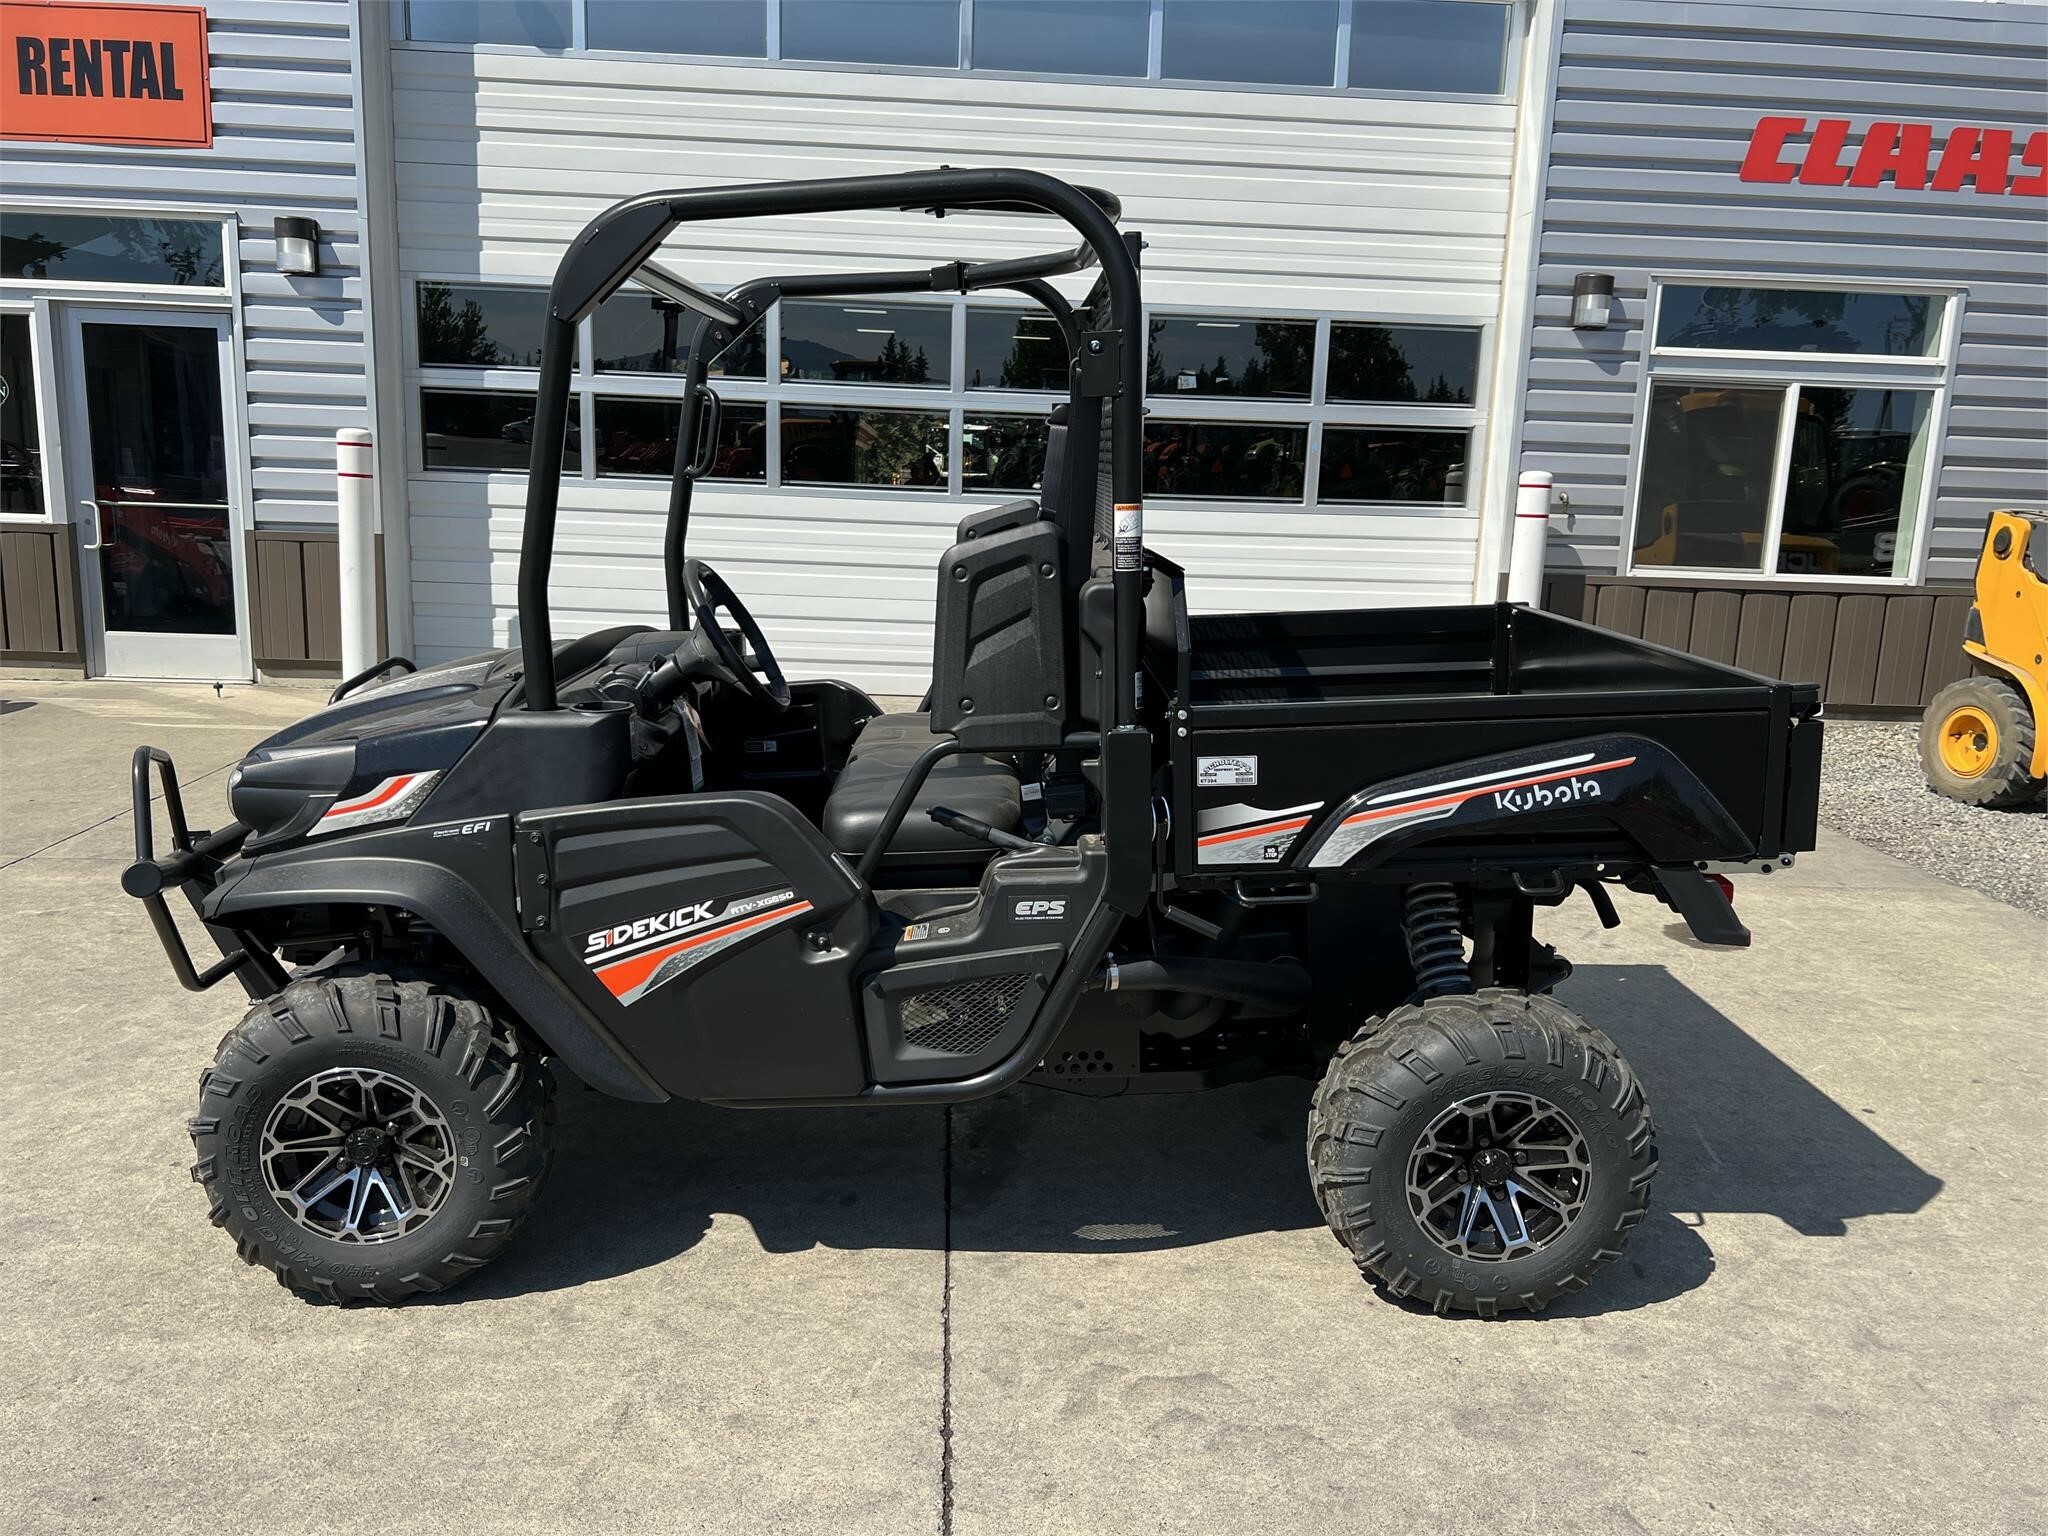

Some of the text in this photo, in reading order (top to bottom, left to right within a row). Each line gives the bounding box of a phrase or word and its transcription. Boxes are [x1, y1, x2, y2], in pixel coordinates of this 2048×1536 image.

[16, 36, 184, 101] RENTAL
[1494, 777, 1601, 812] Kubota
[461, 821, 491, 835] EFI
[730, 891, 795, 915] RTV-XG850
[1015, 900, 1066, 915] EPS
[585, 900, 714, 953] SIDEKICK
[226, 1168, 260, 1222] OFF
[256, 1226, 324, 1269] MAG
